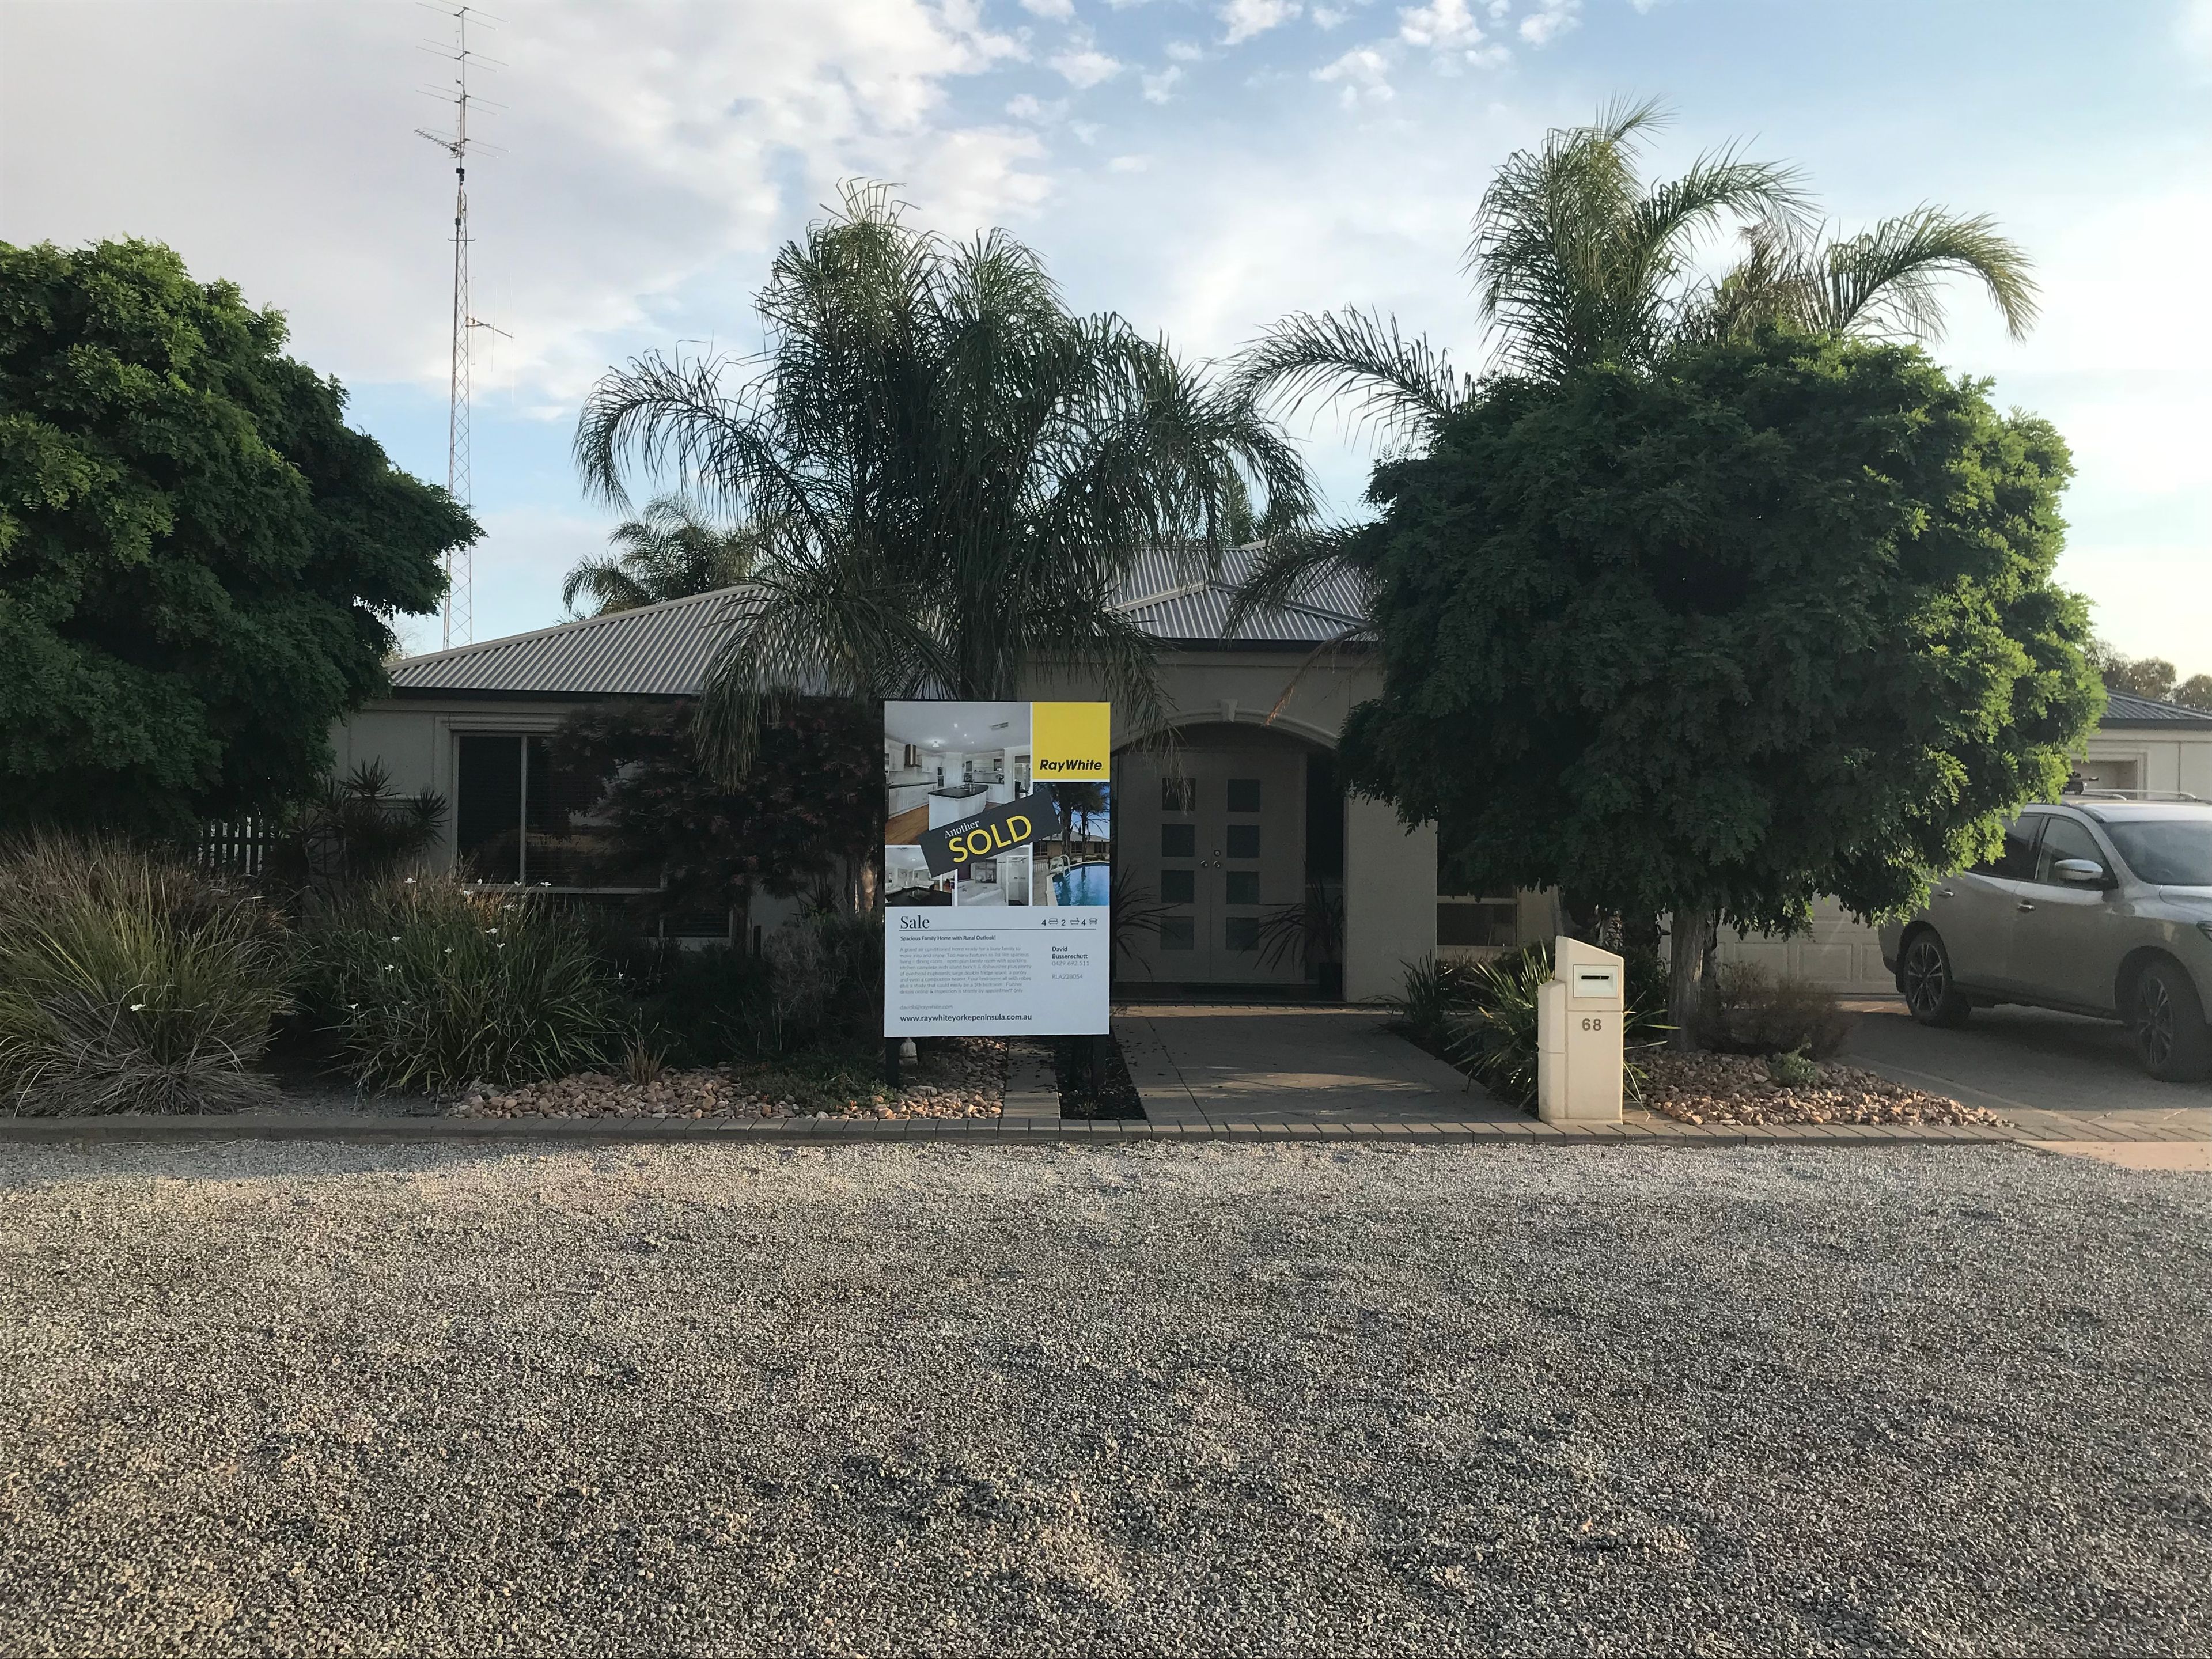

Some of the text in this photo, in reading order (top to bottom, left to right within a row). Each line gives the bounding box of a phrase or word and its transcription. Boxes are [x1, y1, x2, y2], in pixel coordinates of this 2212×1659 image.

[945, 821, 979, 839] Another
[949, 815, 1032, 862] SOLD
[900, 915, 930, 929] Sale
[900, 1014, 1032, 1022] www.raywhiteyorkepeninsula.com.au
[1582, 1018, 1602, 1031] 68
